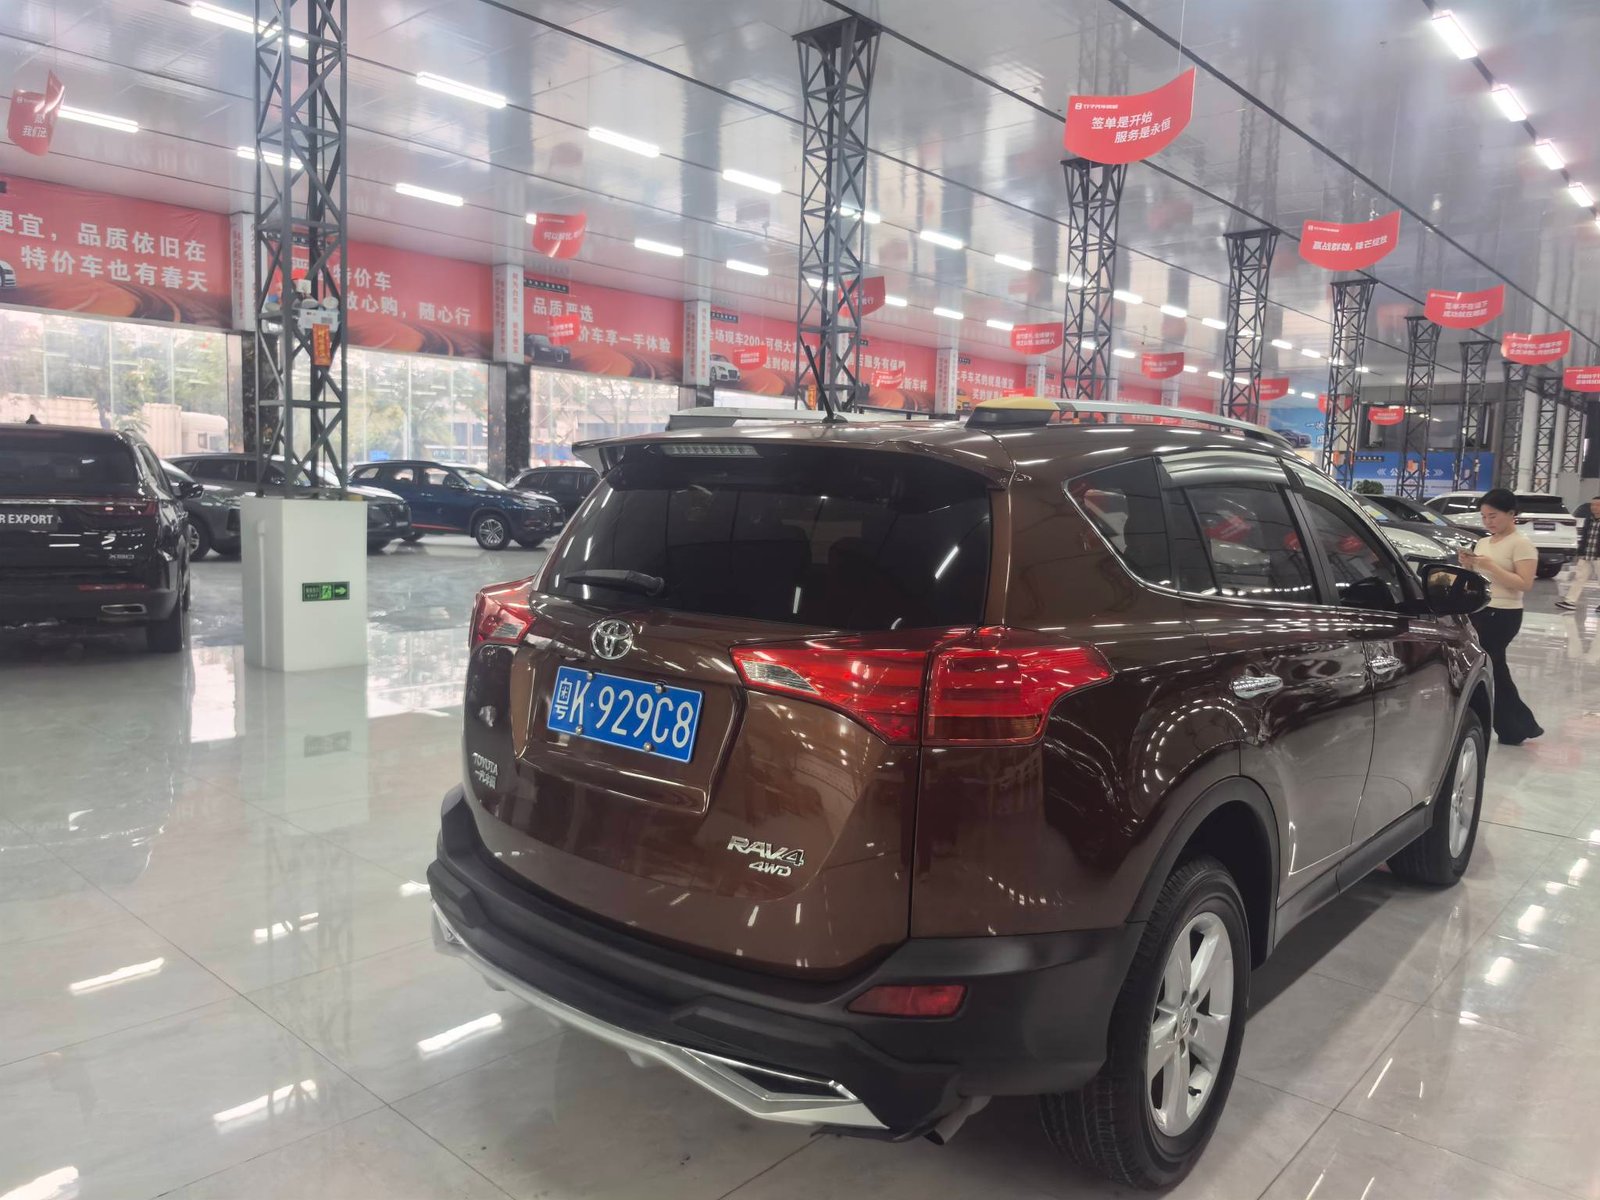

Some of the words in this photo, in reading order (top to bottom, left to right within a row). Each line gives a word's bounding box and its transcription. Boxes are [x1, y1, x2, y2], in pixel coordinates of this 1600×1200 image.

[1091, 111, 1153, 130] 签单是开始
[1114, 117, 1171, 144] 服务是永恒
[20, 245, 208, 292] 特价车也有春天
[8, 514, 53, 524] EXPORT
[553, 678, 694, 749] 粤K·929C8
[727, 836, 804, 867] RAV4
[748, 861, 792, 877] 4WD
